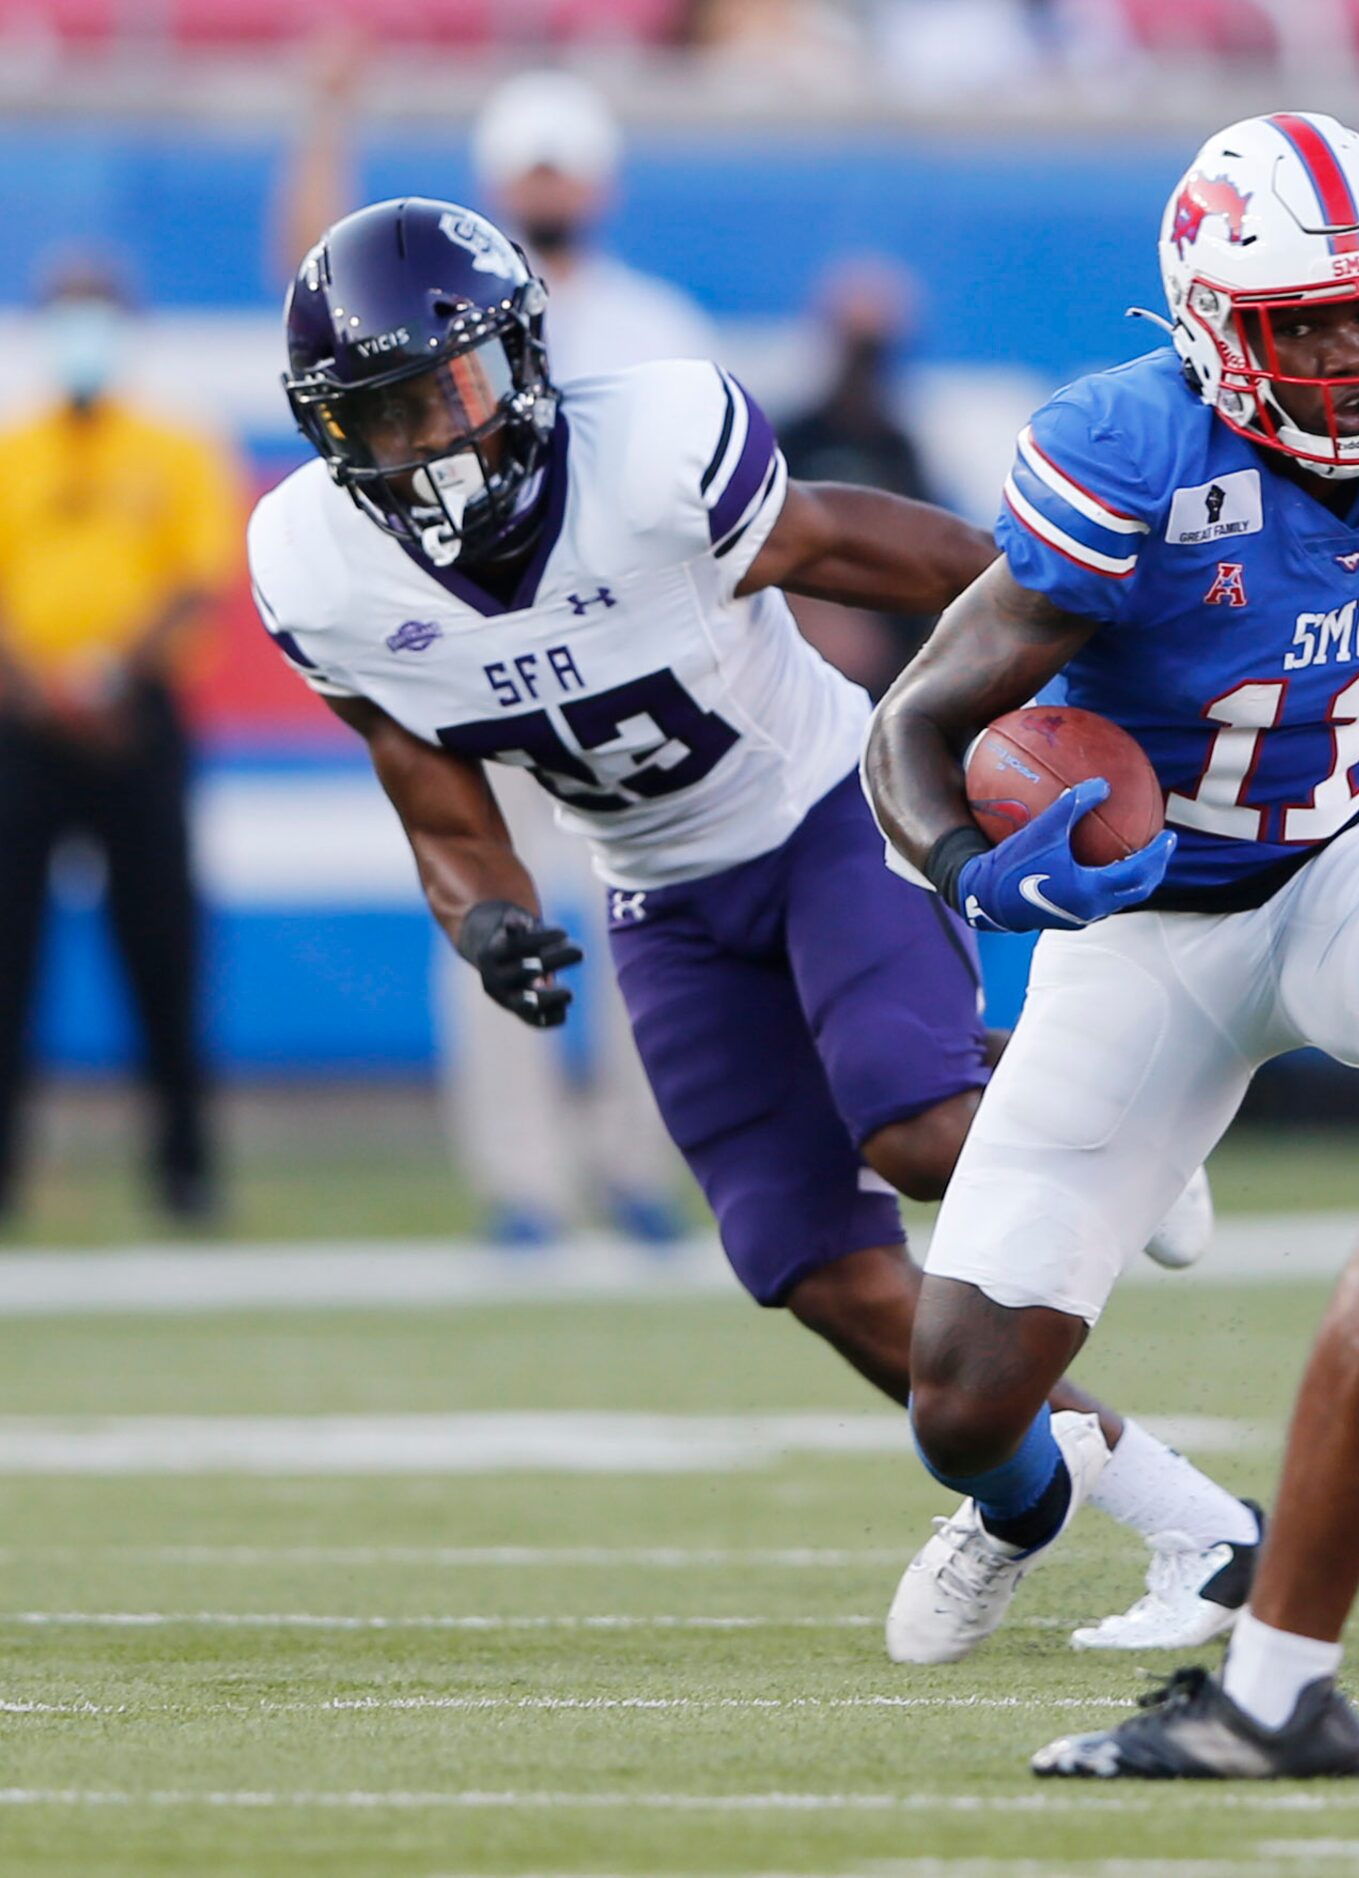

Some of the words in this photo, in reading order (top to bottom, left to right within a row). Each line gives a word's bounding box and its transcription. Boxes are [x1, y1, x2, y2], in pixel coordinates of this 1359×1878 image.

[357, 327, 410, 358] VICIS
[1179, 527, 1213, 543] GREAT
[1213, 520, 1249, 537] FAMILY
[483, 645, 586, 707] SFA
